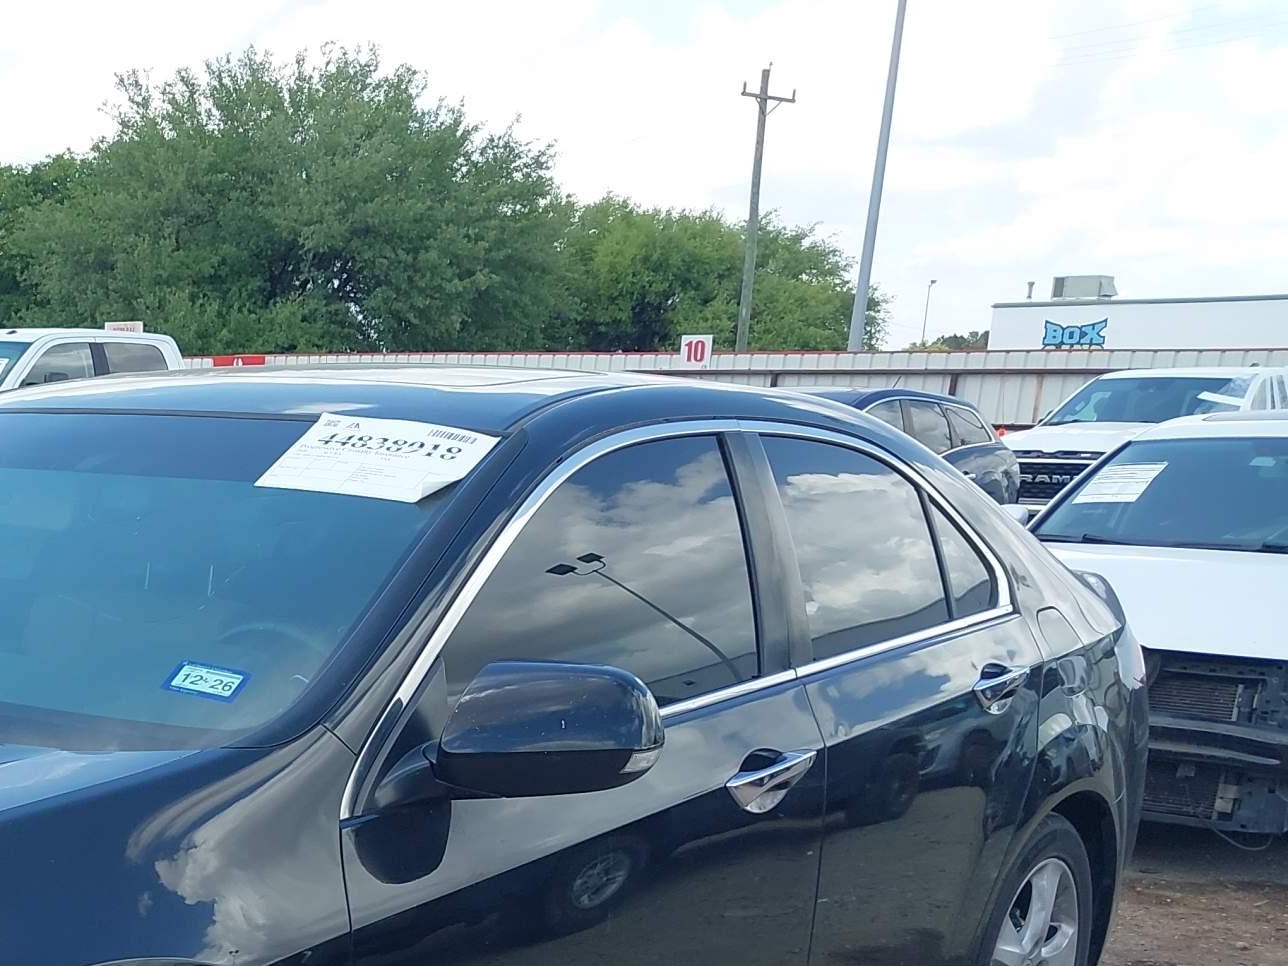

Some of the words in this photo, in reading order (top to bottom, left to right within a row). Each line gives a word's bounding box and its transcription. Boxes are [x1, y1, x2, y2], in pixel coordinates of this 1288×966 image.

[1042, 317, 1108, 345] BOX
[685, 340, 706, 363] 10
[317, 433, 462, 461] 44838918
[1016, 474, 1071, 483] RAM
